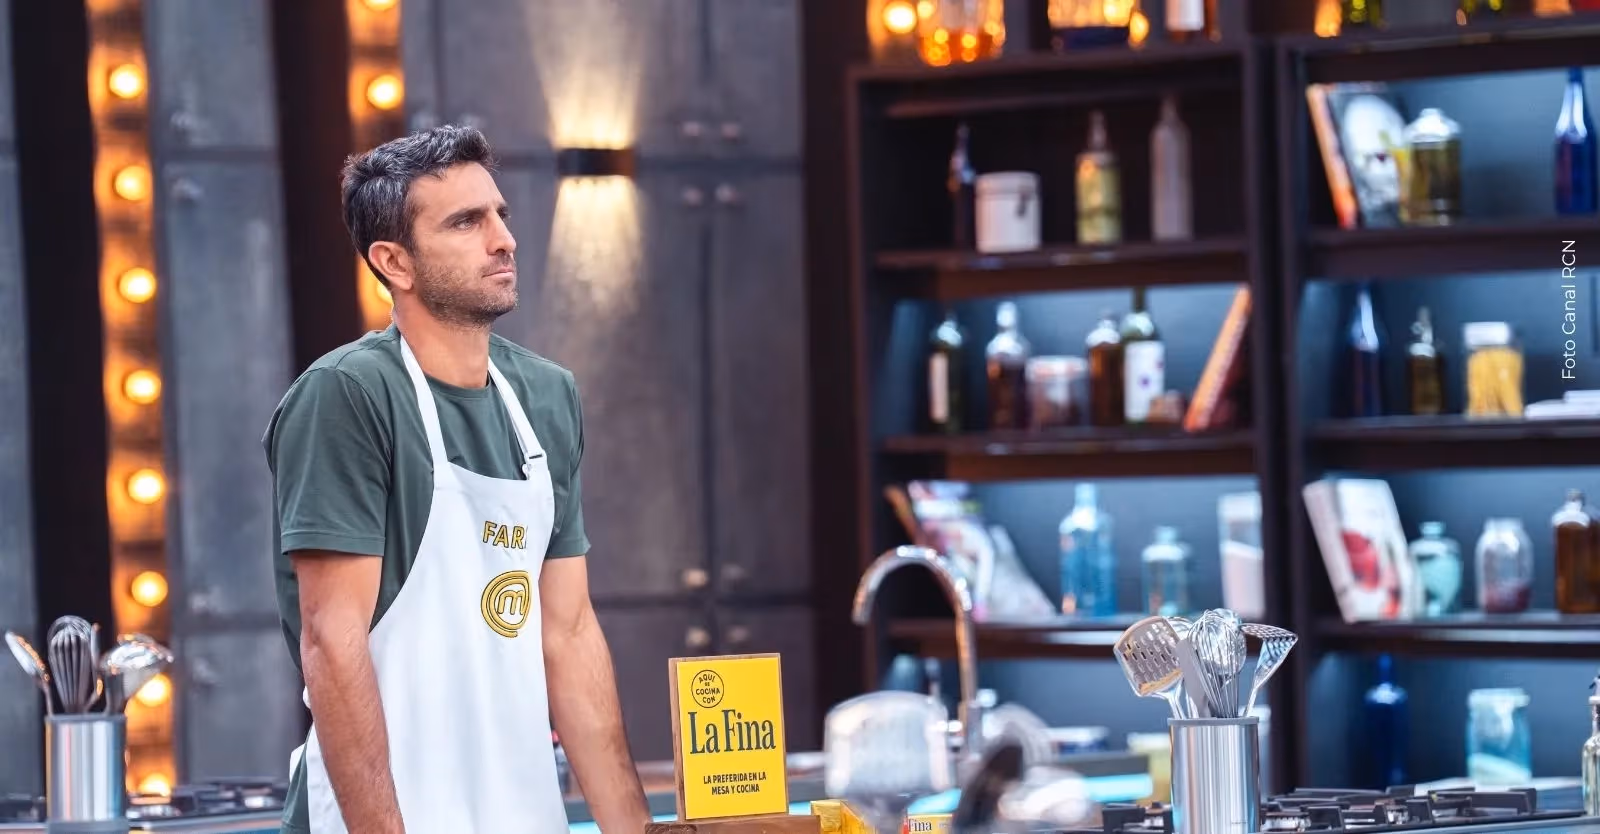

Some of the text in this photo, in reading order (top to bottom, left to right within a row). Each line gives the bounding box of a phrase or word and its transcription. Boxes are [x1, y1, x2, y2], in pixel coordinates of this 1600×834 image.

[482, 520, 528, 549] FAR
[695, 687, 720, 695] COCINA
[702, 695, 716, 704] CON
[687, 709, 776, 754] La Fina
[703, 771, 767, 784] LA PREFERIDA EN LA
[711, 783, 760, 796] MESA Y COCINA
